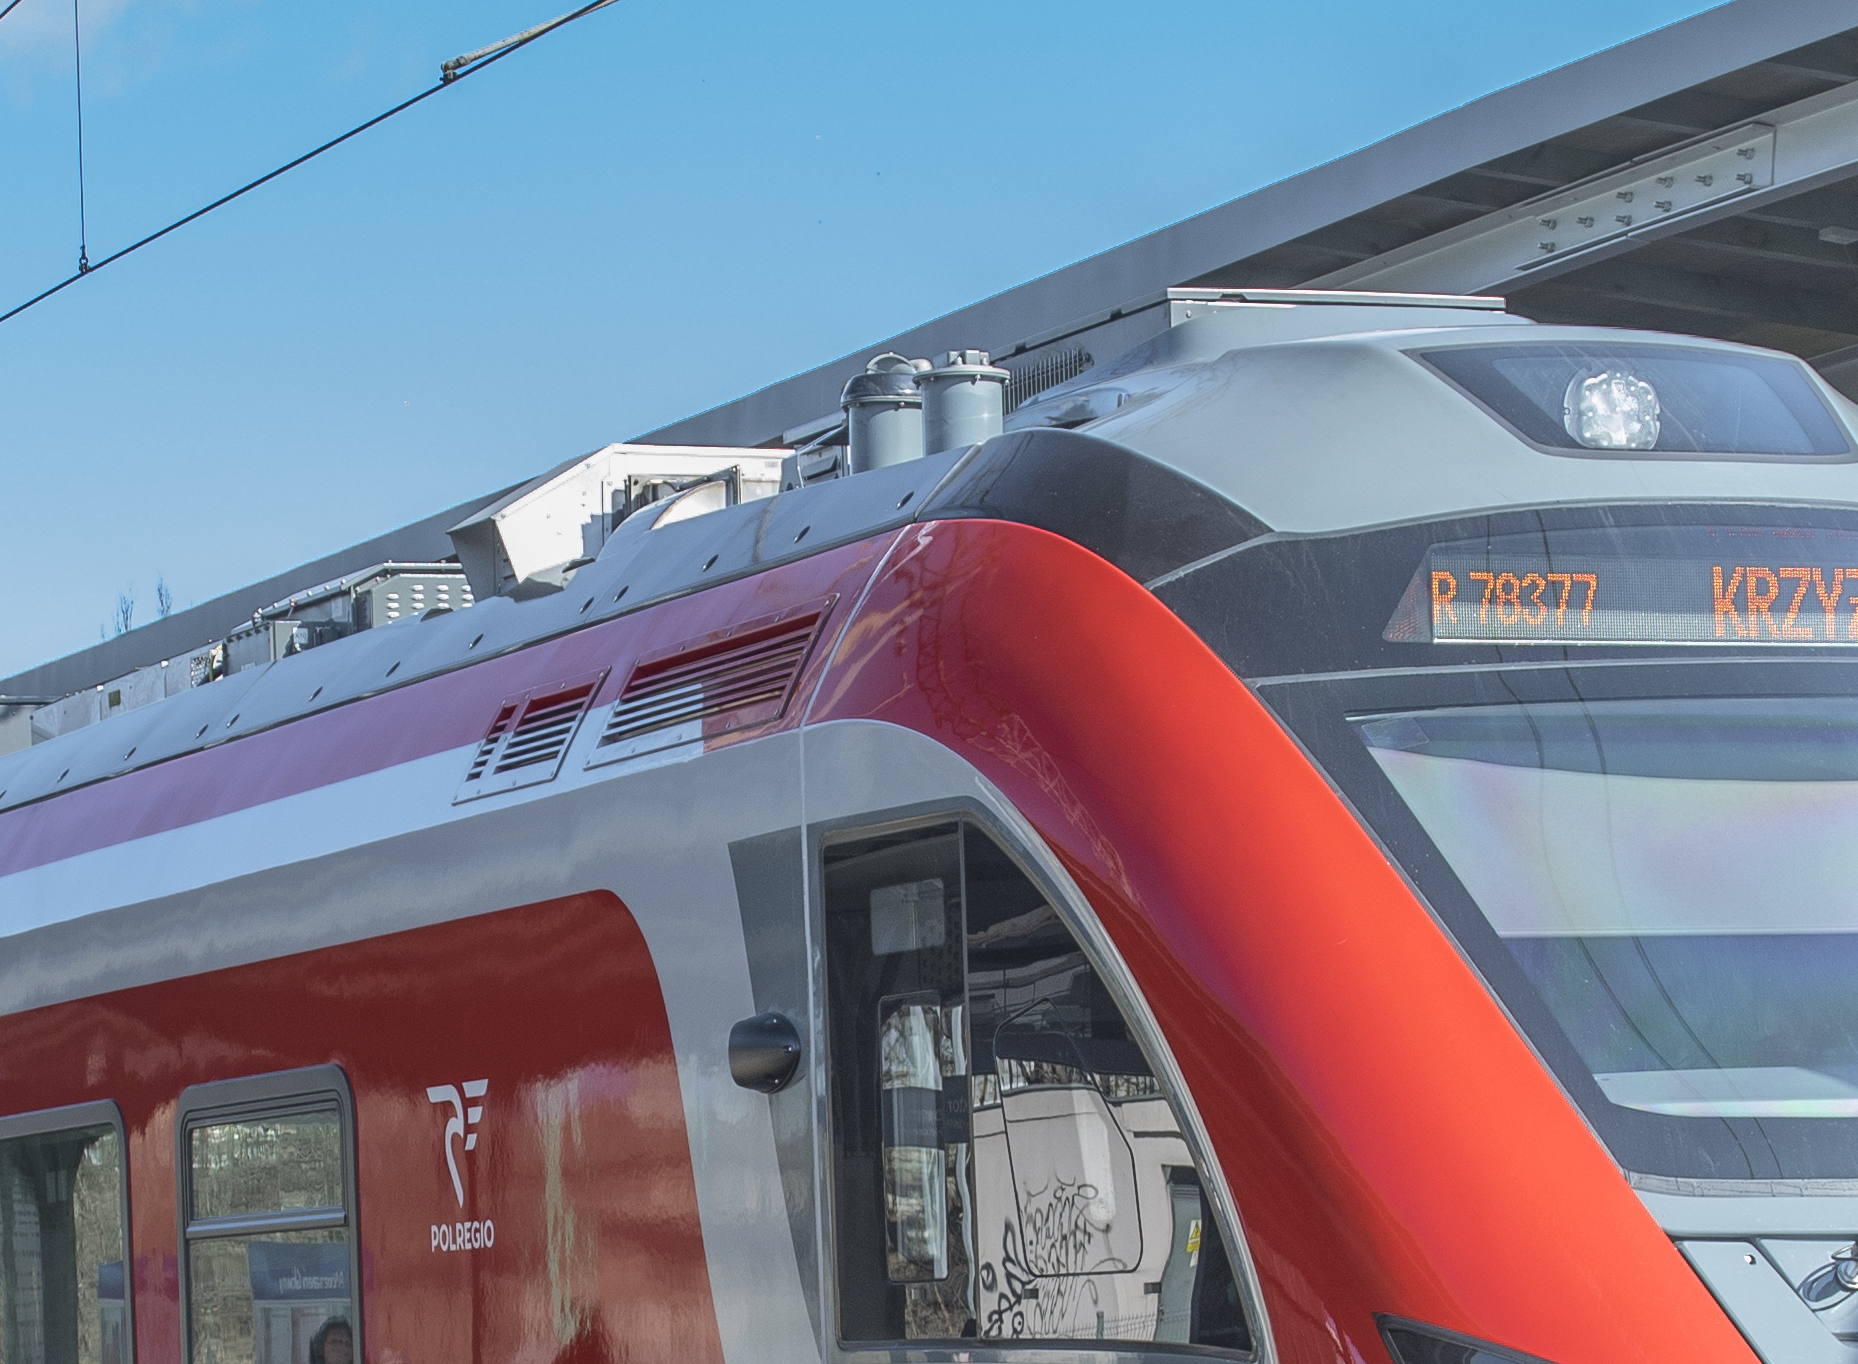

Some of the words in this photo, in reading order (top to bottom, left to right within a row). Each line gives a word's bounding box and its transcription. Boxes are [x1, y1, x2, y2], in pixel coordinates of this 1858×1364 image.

[1433, 571, 1458, 625] R
[1469, 571, 1597, 628] 78377
[431, 1219, 495, 1252] POLREGIO
